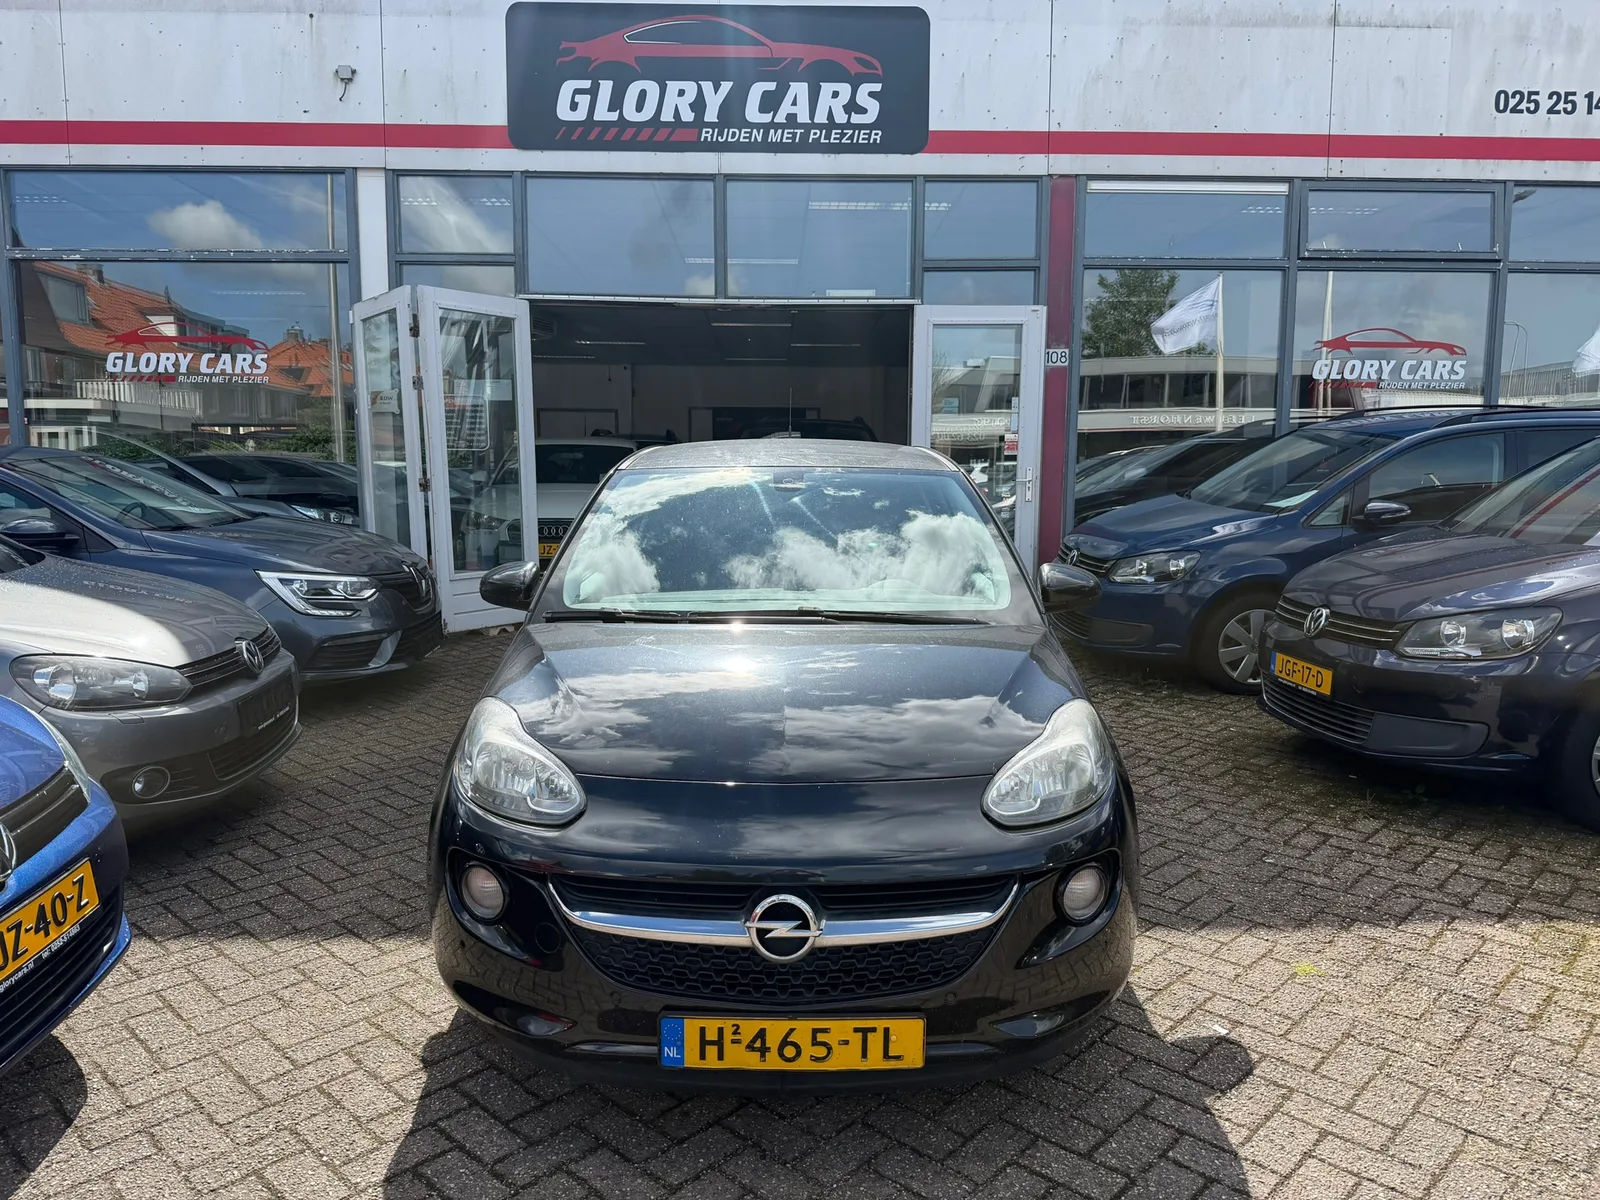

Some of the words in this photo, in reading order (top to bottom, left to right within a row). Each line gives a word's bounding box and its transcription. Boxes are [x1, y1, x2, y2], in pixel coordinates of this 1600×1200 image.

[556, 79, 733, 123] GLORY
[744, 81, 882, 124] CARS
[1494, 89, 1540, 115] 025
[1546, 91, 1577, 115] 25
[700, 127, 763, 142] RIJDEN
[767, 128, 804, 143] MET
[808, 129, 882, 144] PLEZIER
[106, 352, 194, 373] GLORY
[199, 353, 268, 374] CARS
[1046, 350, 1068, 364] 108
[1312, 359, 1396, 380] GLORY
[1400, 360, 1467, 380] CARS
[178, 375, 210, 383] RIJDEN
[232, 376, 269, 384] PLEZIER
[1378, 381, 1410, 389] RIJDEN
[541, 545, 558, 555] JZ-
[1278, 657, 1324, 688] JGF-17-D
[664, 1046, 681, 1058] NL
